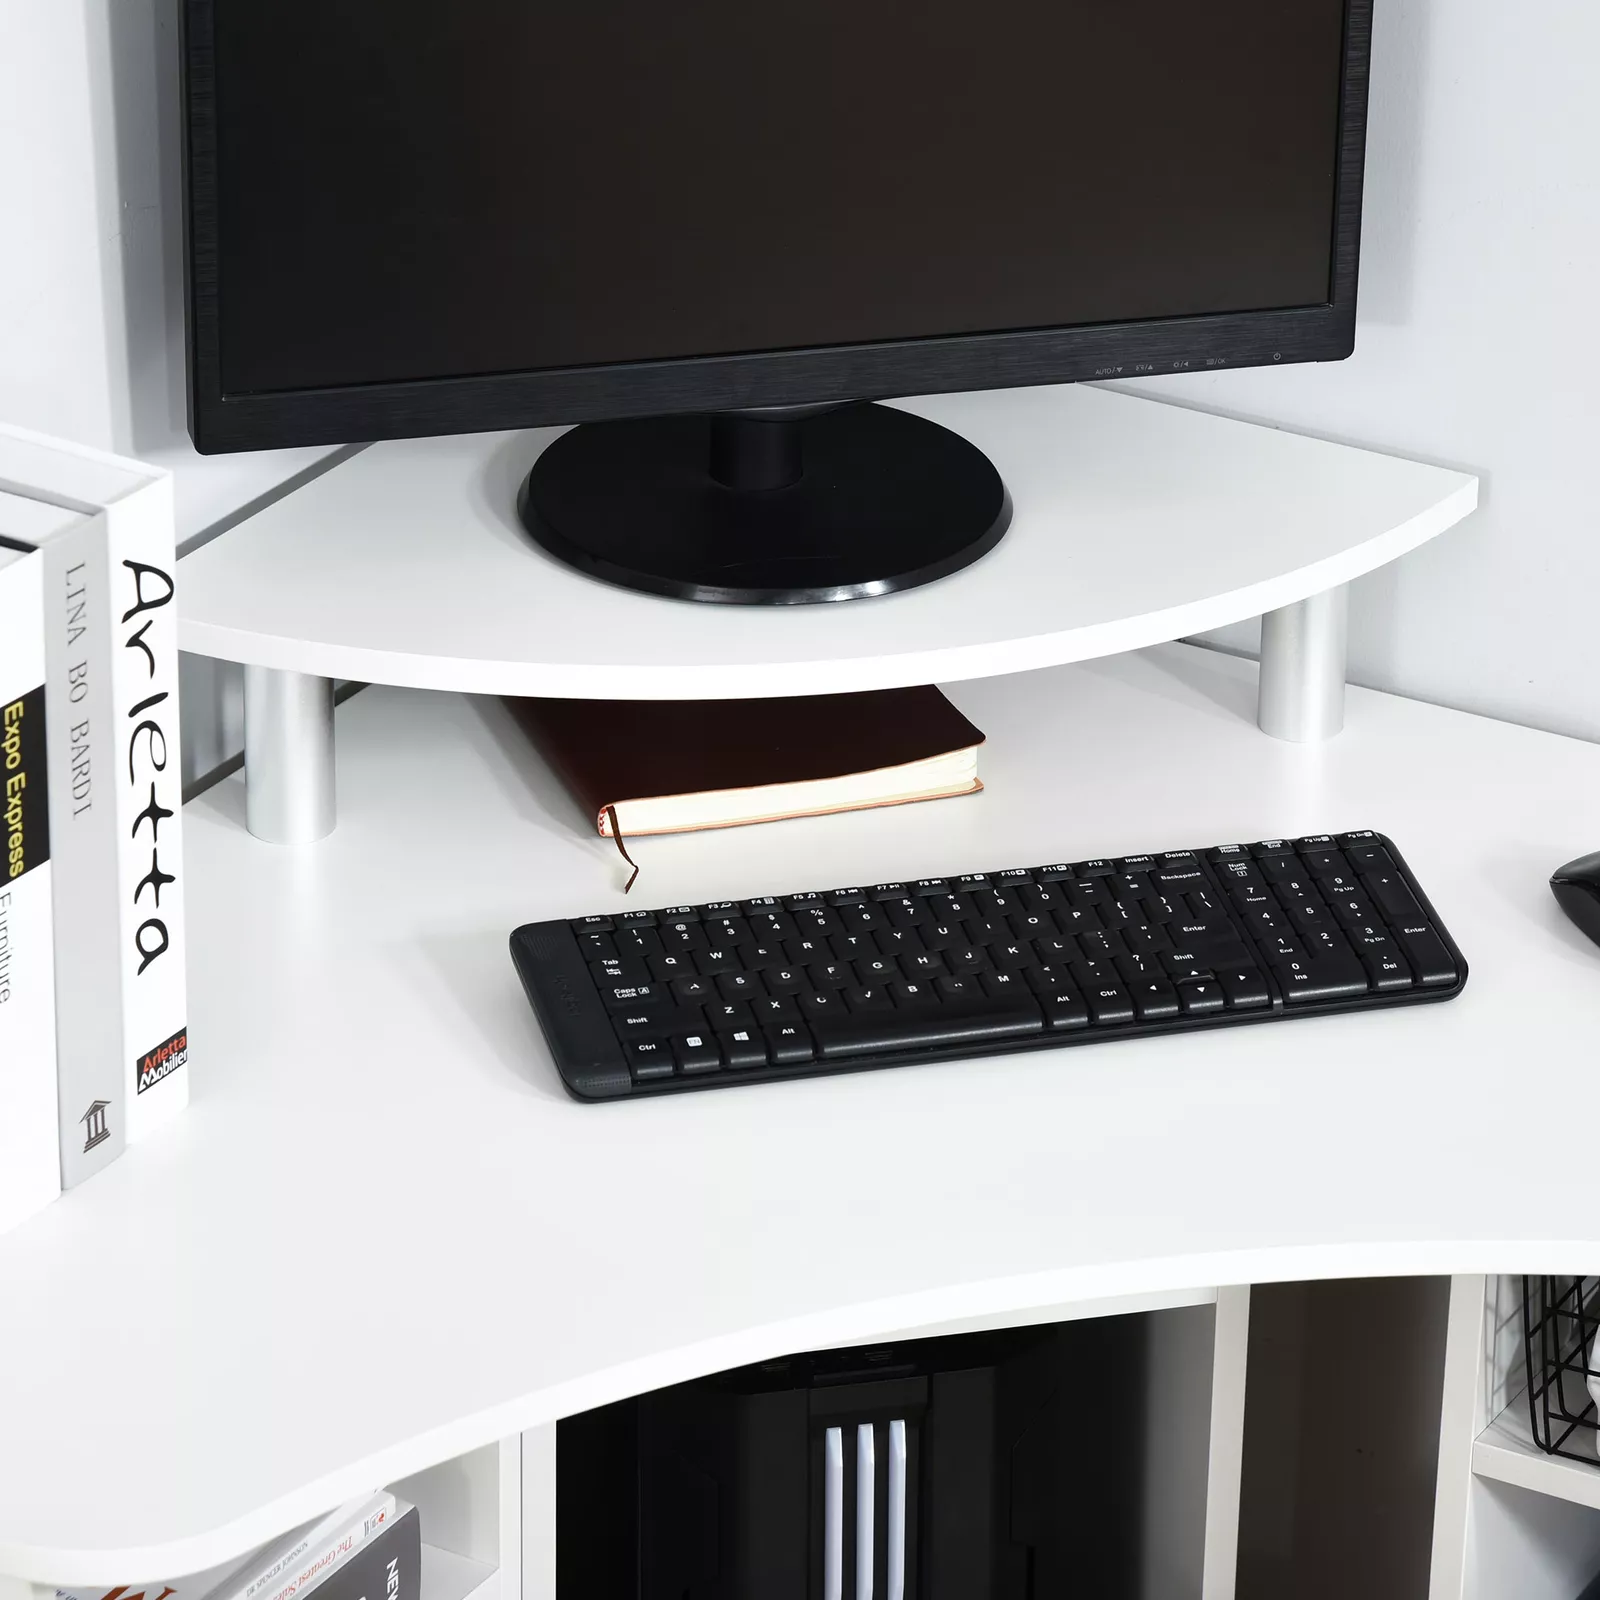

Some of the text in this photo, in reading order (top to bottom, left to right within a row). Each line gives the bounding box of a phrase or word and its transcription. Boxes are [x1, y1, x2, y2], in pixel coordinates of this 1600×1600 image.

[66, 562, 92, 821] LINA BO BARDI
[121, 559, 175, 977] Arletta
[1, 700, 26, 878] Expo Express
[1124, 855, 1149, 863] Insert
[1164, 851, 1191, 859] Delete
[613, 987, 636, 995] Caps
[138, 1049, 188, 1093] Mobilier
[143, 1035, 187, 1073] Arletta
[339, 1535, 353, 1552] The
[297, 1550, 337, 1585] Greatest
